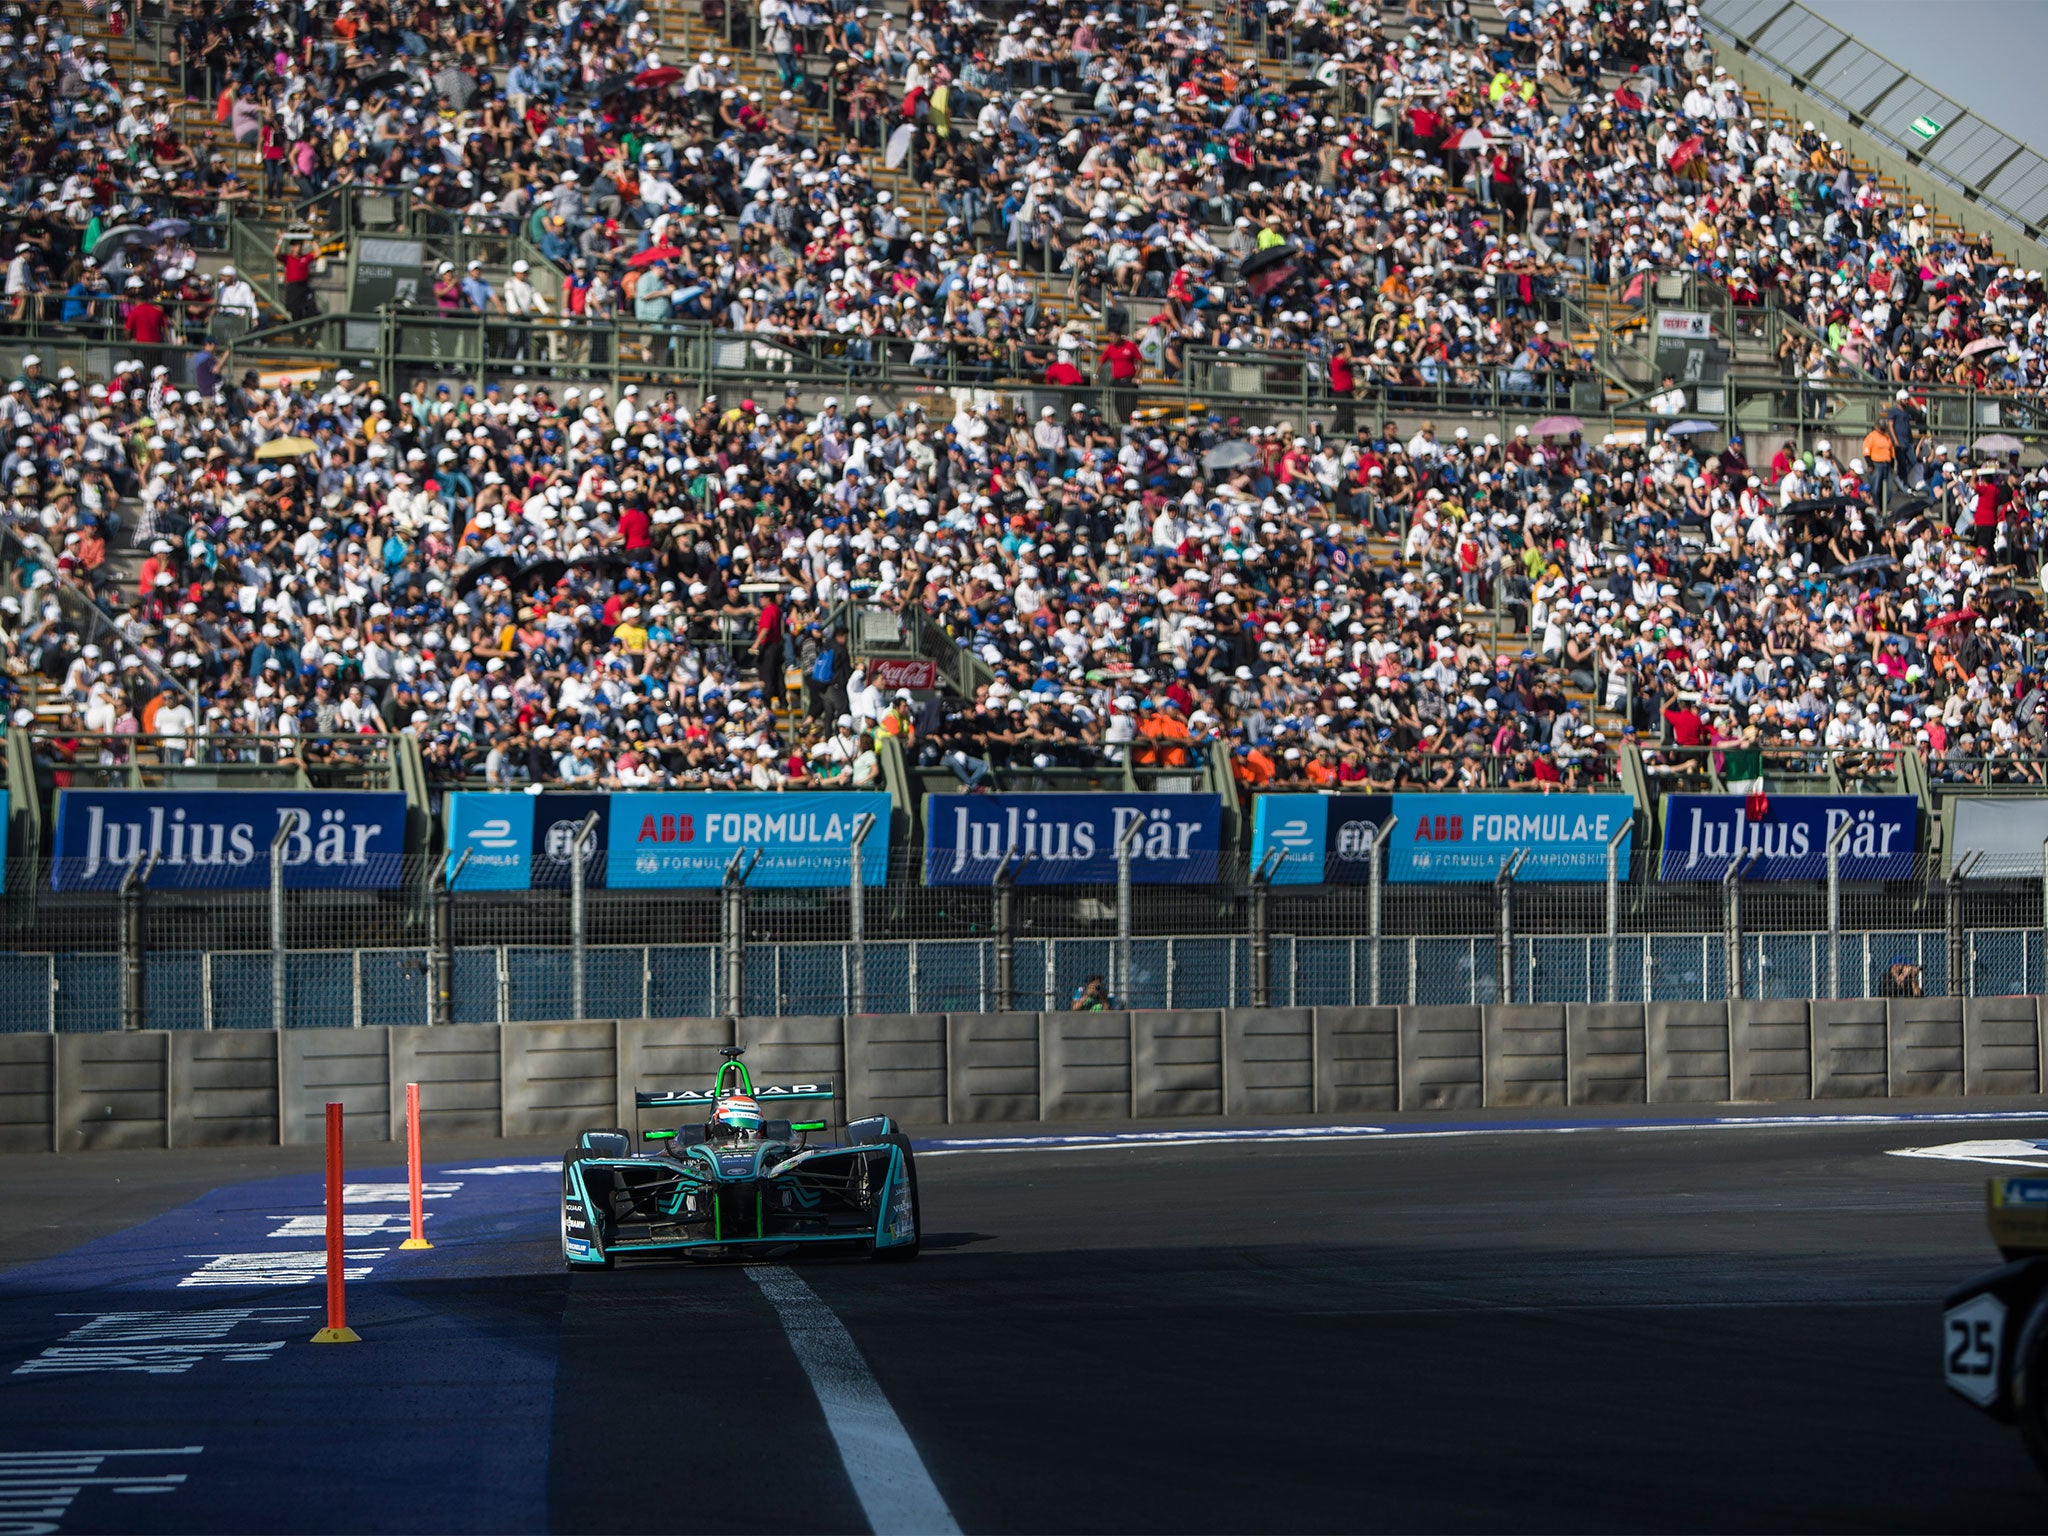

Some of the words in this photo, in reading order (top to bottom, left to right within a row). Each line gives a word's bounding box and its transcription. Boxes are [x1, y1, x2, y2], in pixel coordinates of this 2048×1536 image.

[82, 806, 254, 878] Julius
[276, 807, 381, 866] Bär
[638, 814, 695, 843] ABB
[951, 807, 1095, 874] Julius
[1110, 807, 1201, 860] Bär
[1414, 815, 1463, 842] ABB
[1685, 808, 1809, 870] Julius
[1823, 808, 1901, 859] Bär
[663, 857, 731, 870] FORMULA
[756, 856, 865, 869] CHAMPIONSH
[1436, 854, 1494, 867] FORMULA
[652, 1085, 818, 1101] JAGUAR
[1950, 1319, 1994, 1376] 25
